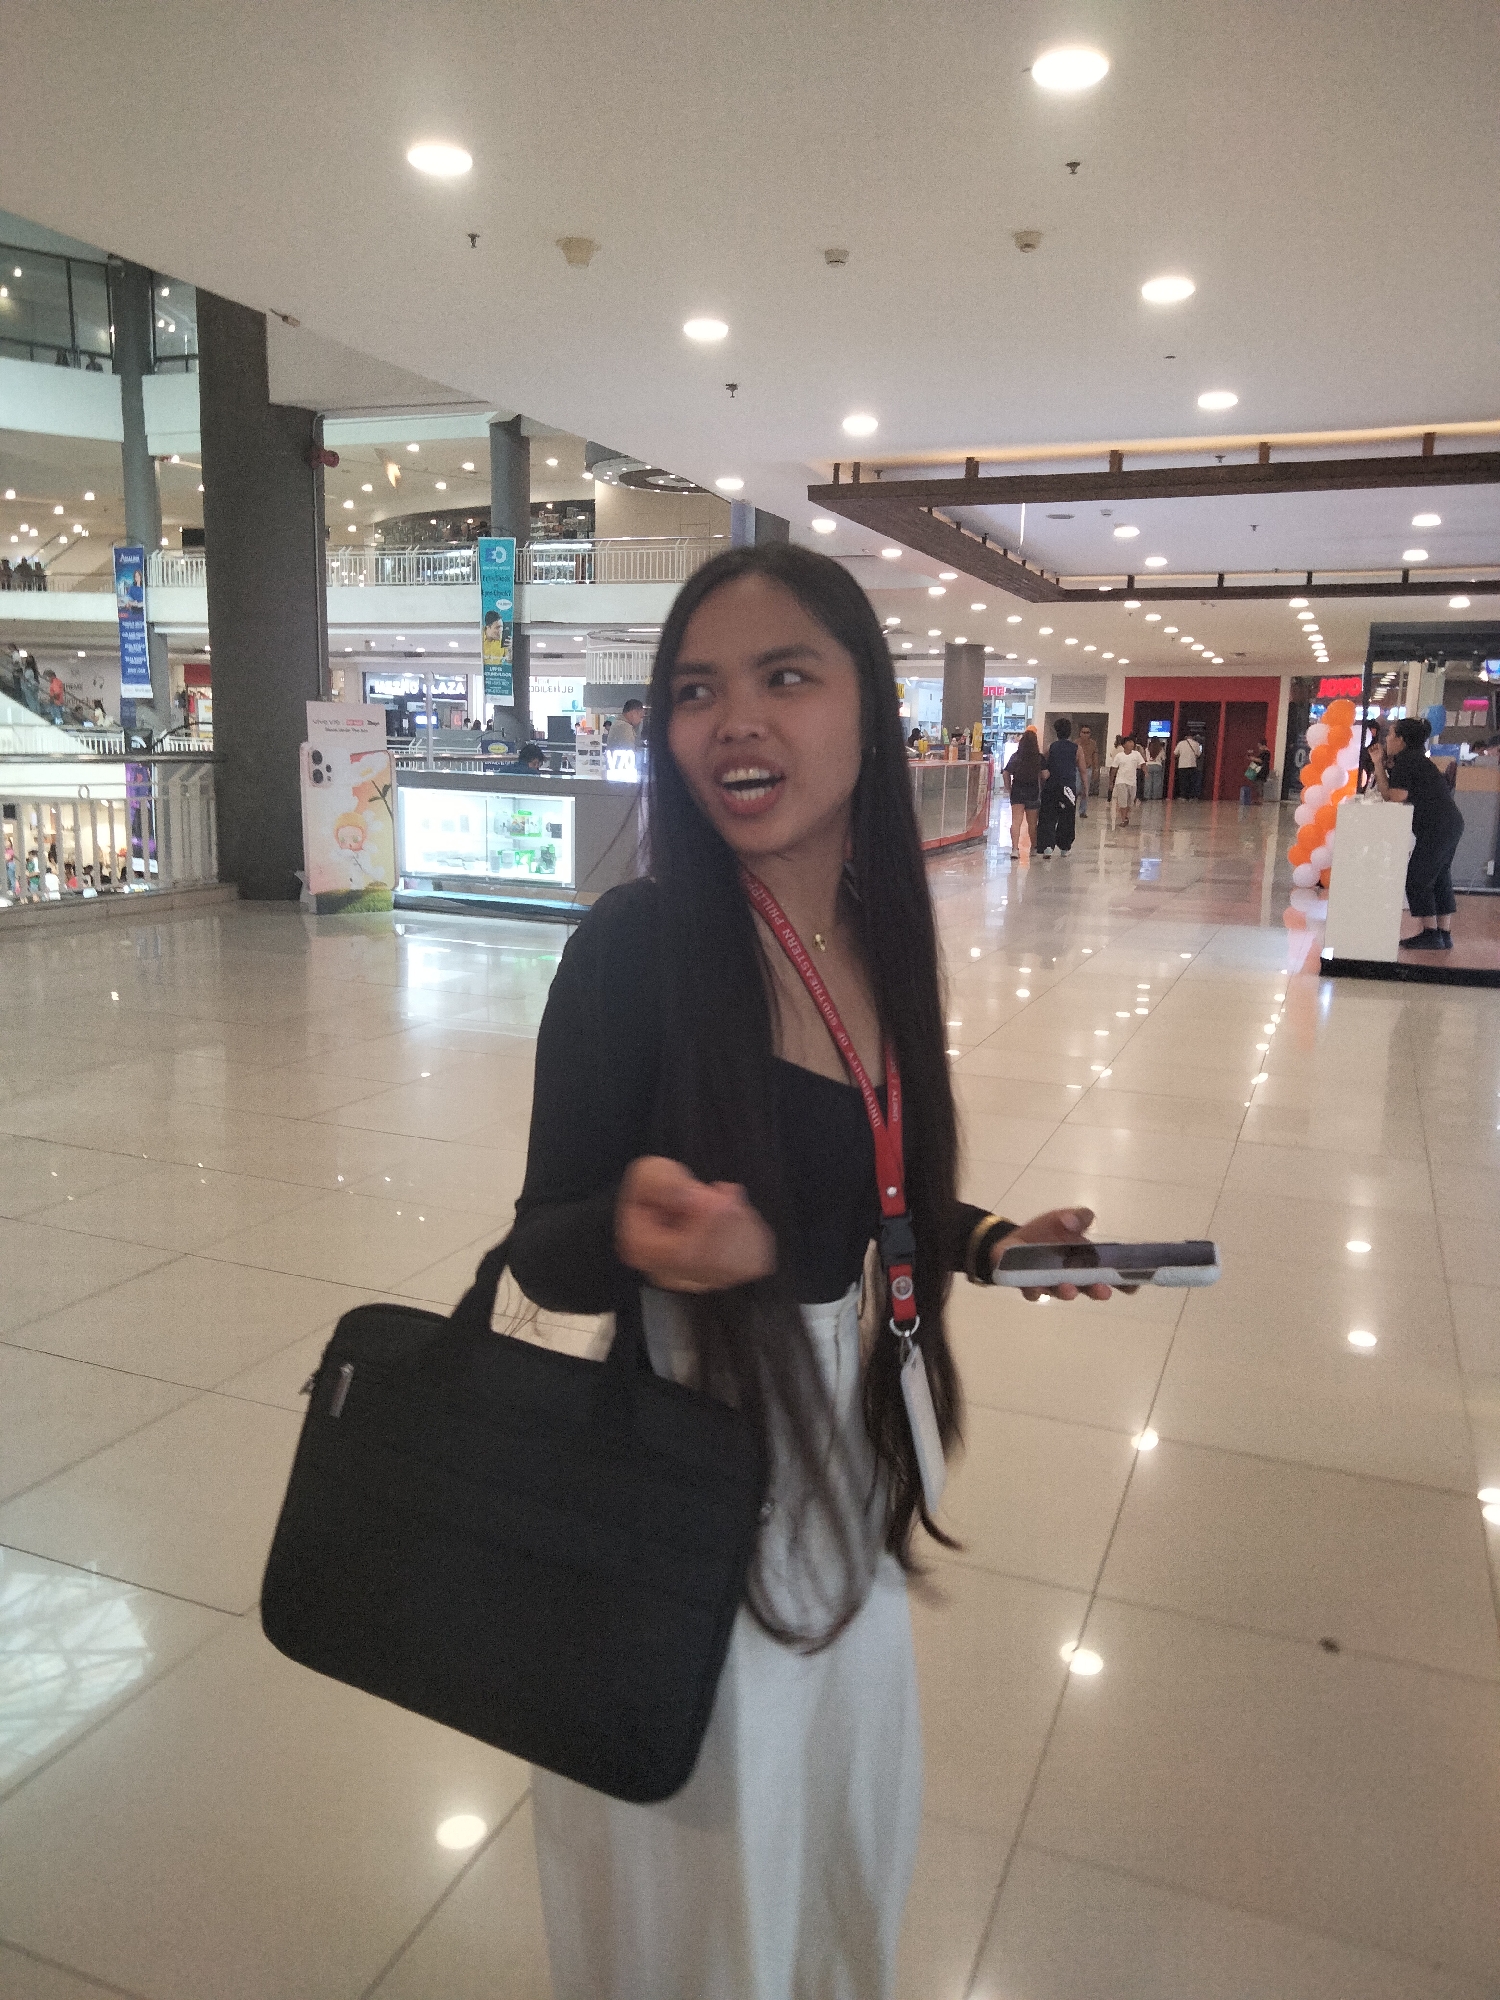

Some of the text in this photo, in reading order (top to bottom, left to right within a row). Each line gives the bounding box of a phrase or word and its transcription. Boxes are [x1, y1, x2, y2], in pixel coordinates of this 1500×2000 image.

[781, 927, 837, 1026] SOUTHEASTERN
[838, 1031, 849, 1047] OF
[847, 1051, 881, 1128] UNIVERSITY
